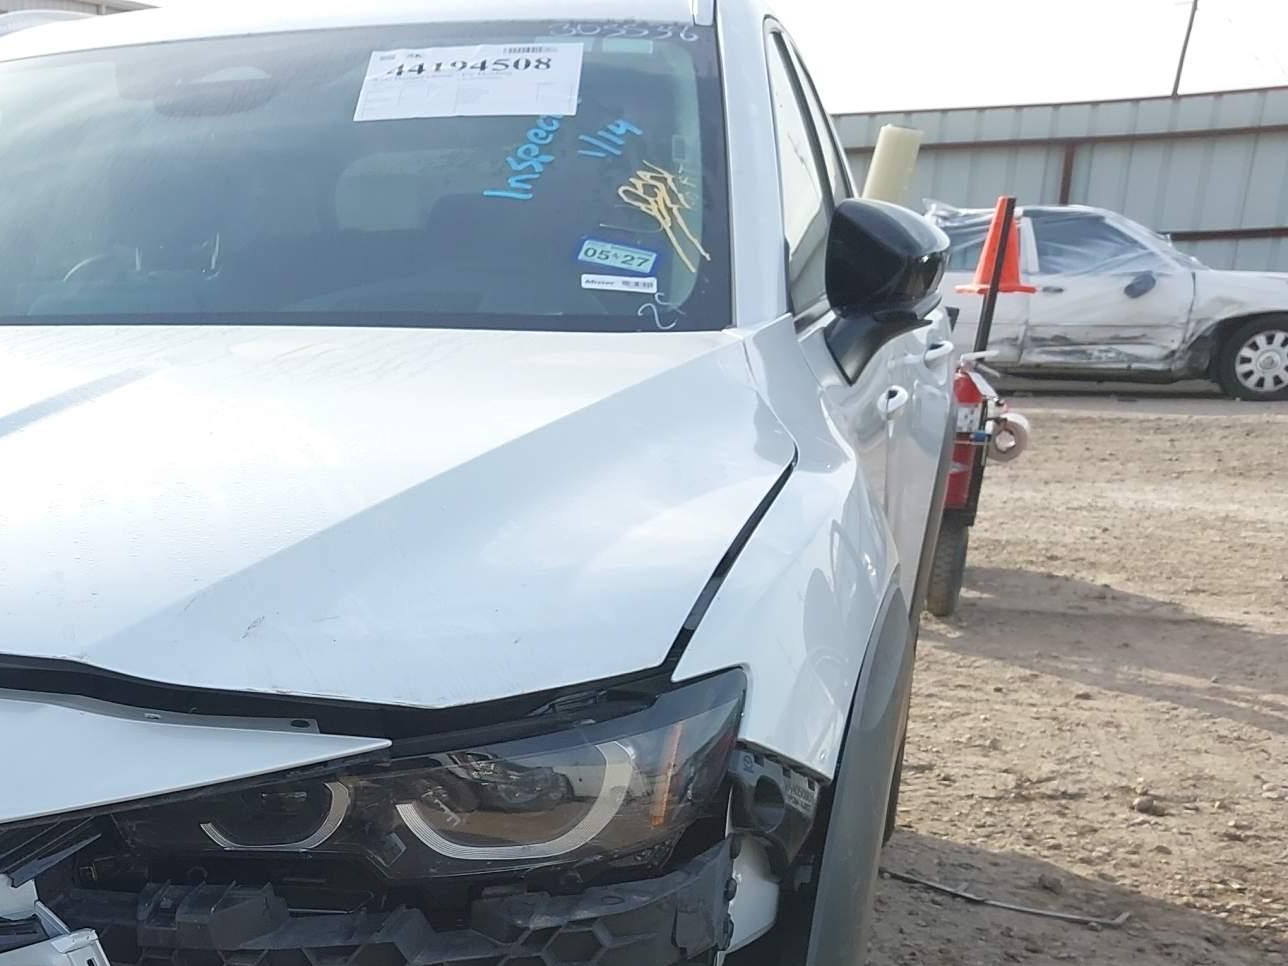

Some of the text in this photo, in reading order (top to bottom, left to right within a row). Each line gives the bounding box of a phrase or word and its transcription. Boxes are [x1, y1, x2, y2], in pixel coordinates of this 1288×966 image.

[386, 57, 552, 77] 44194508
[583, 246, 650, 268] 05 27
